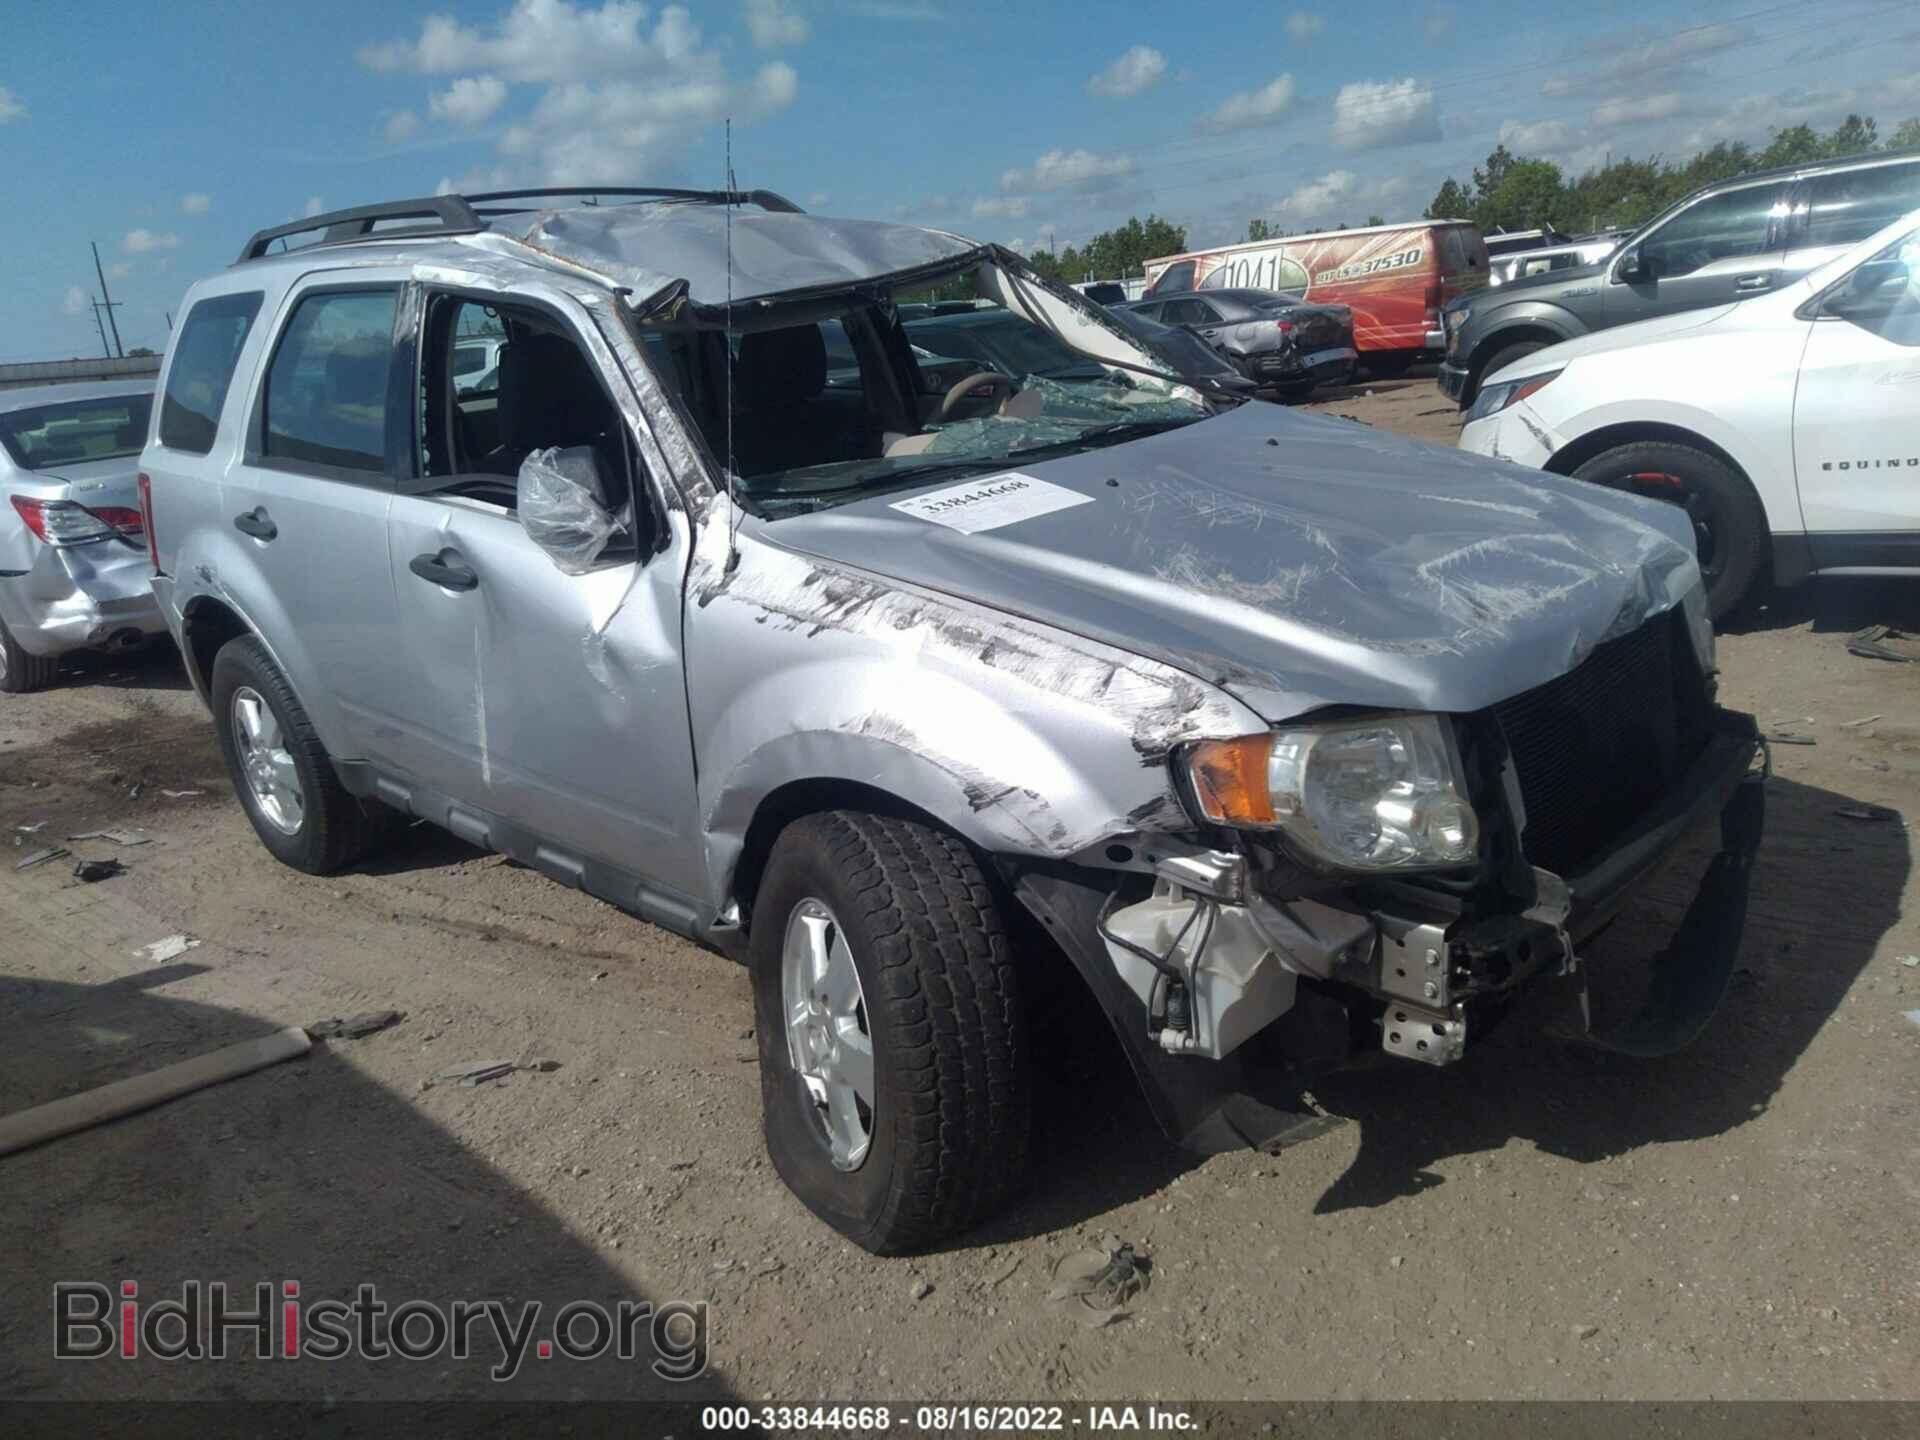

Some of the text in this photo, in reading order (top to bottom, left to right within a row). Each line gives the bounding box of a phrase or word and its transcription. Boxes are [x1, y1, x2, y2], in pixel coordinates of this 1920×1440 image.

[1227, 255, 1278, 289] 1041
[1363, 248, 1422, 273] 37530
[920, 480, 1031, 514] 33844668
